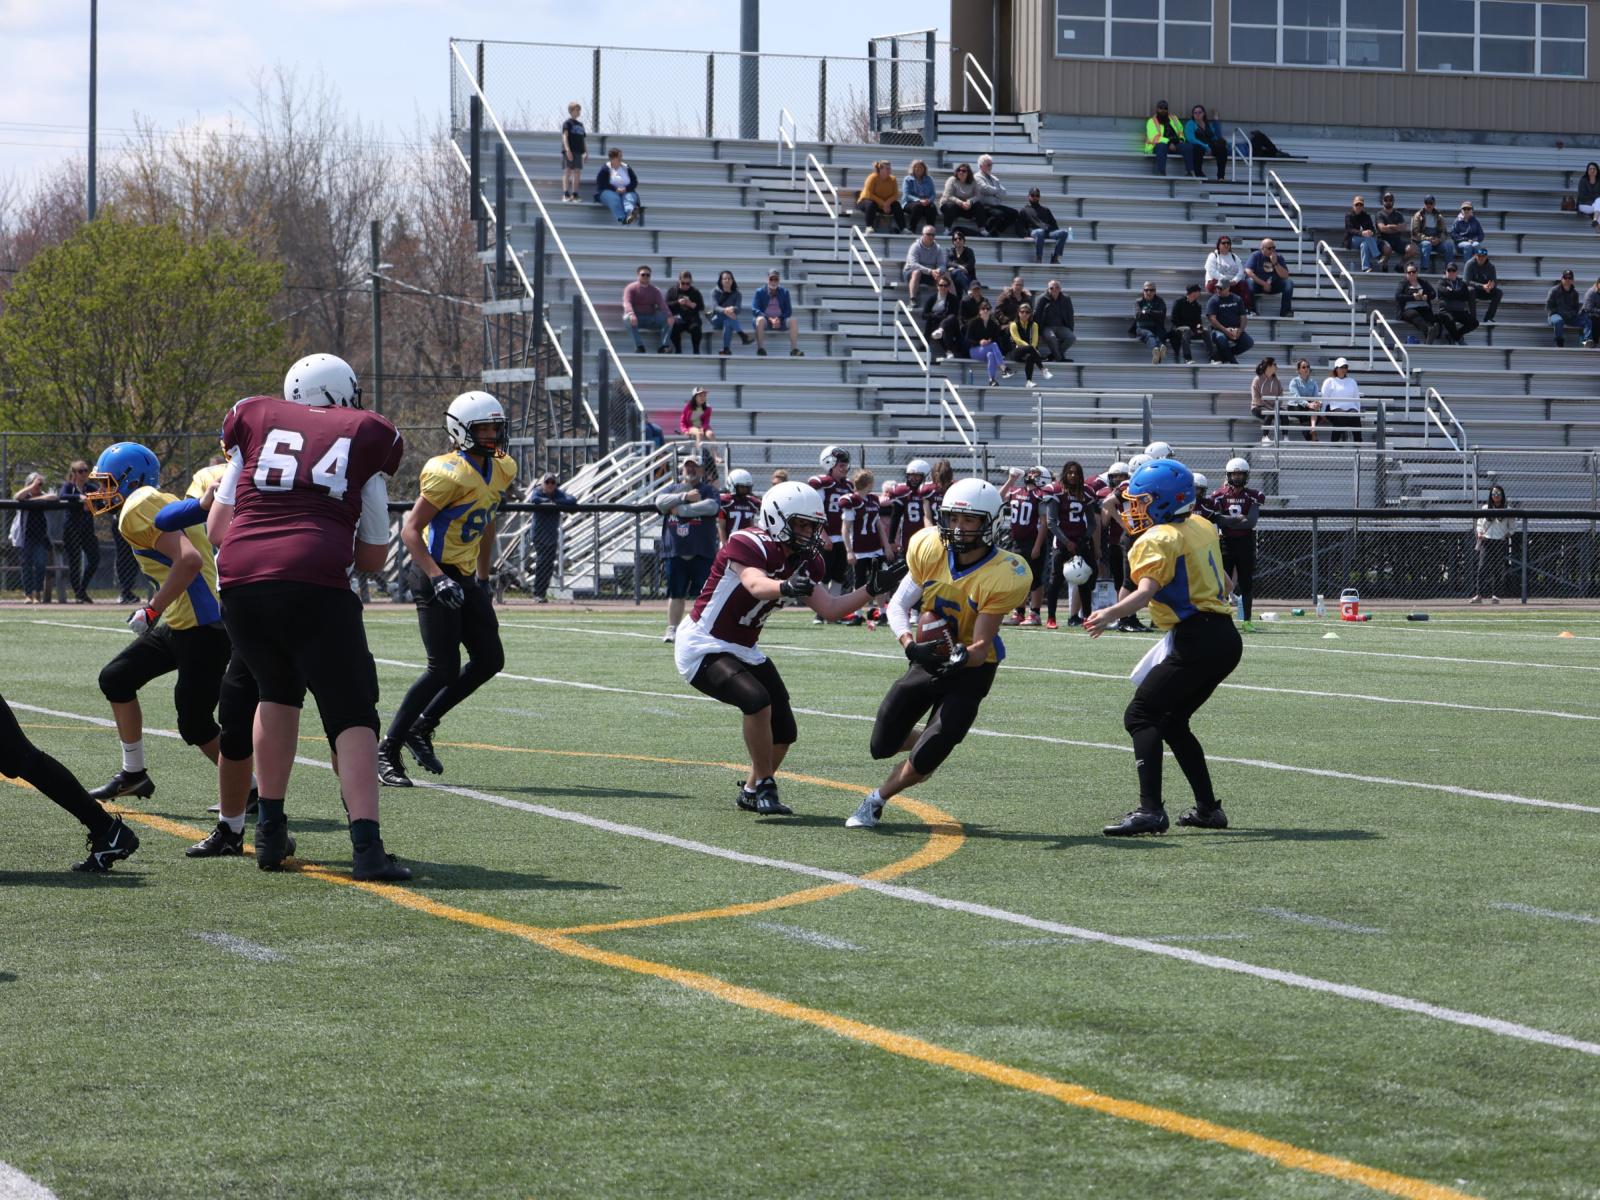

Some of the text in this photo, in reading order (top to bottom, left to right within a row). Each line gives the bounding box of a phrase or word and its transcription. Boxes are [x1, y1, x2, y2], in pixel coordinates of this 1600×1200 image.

[254, 428, 350, 500] 64
[907, 502, 920, 522] 6
[1069, 501, 1083, 522] 2
